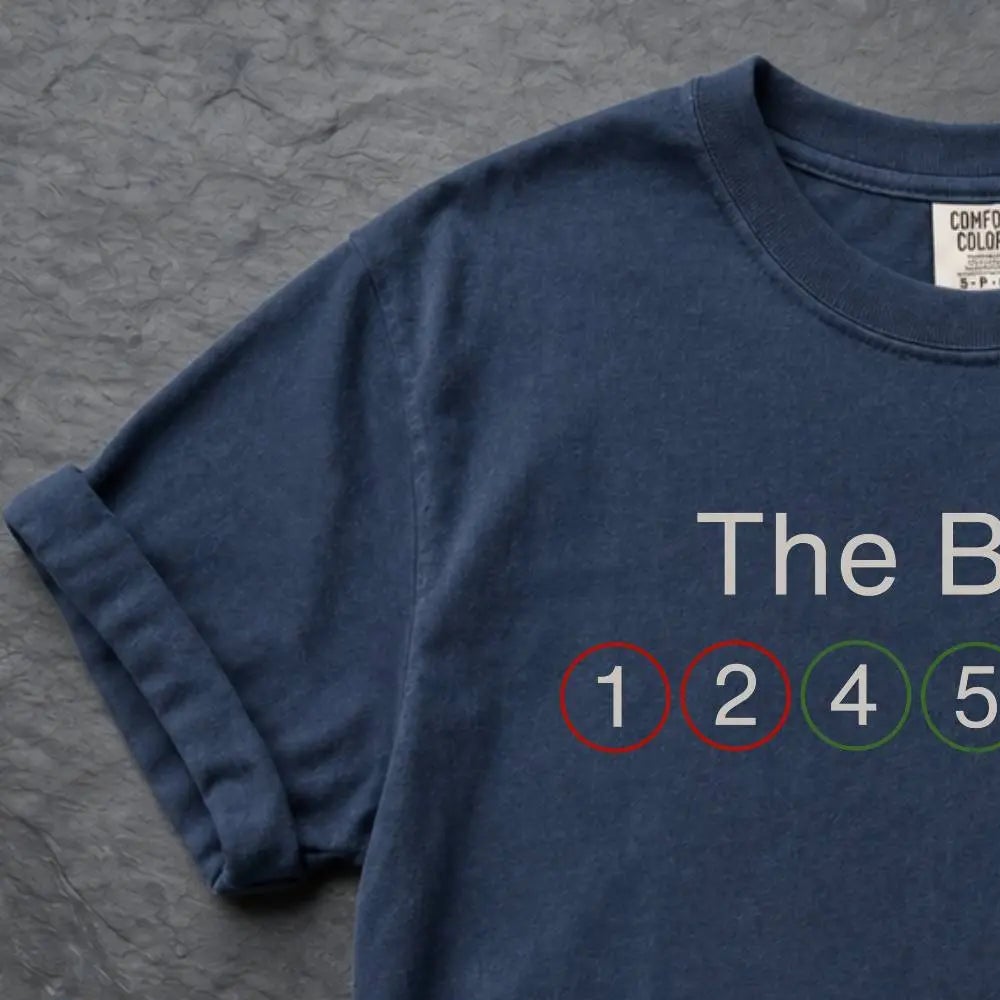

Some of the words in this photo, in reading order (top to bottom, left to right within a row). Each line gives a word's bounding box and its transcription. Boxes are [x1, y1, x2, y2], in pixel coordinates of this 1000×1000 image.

[697, 513, 896, 597] The
[598, 666, 622, 727] 1
[716, 664, 757, 726] 2
[830, 664, 877, 726] 4
[956, 666, 998, 729] 5
